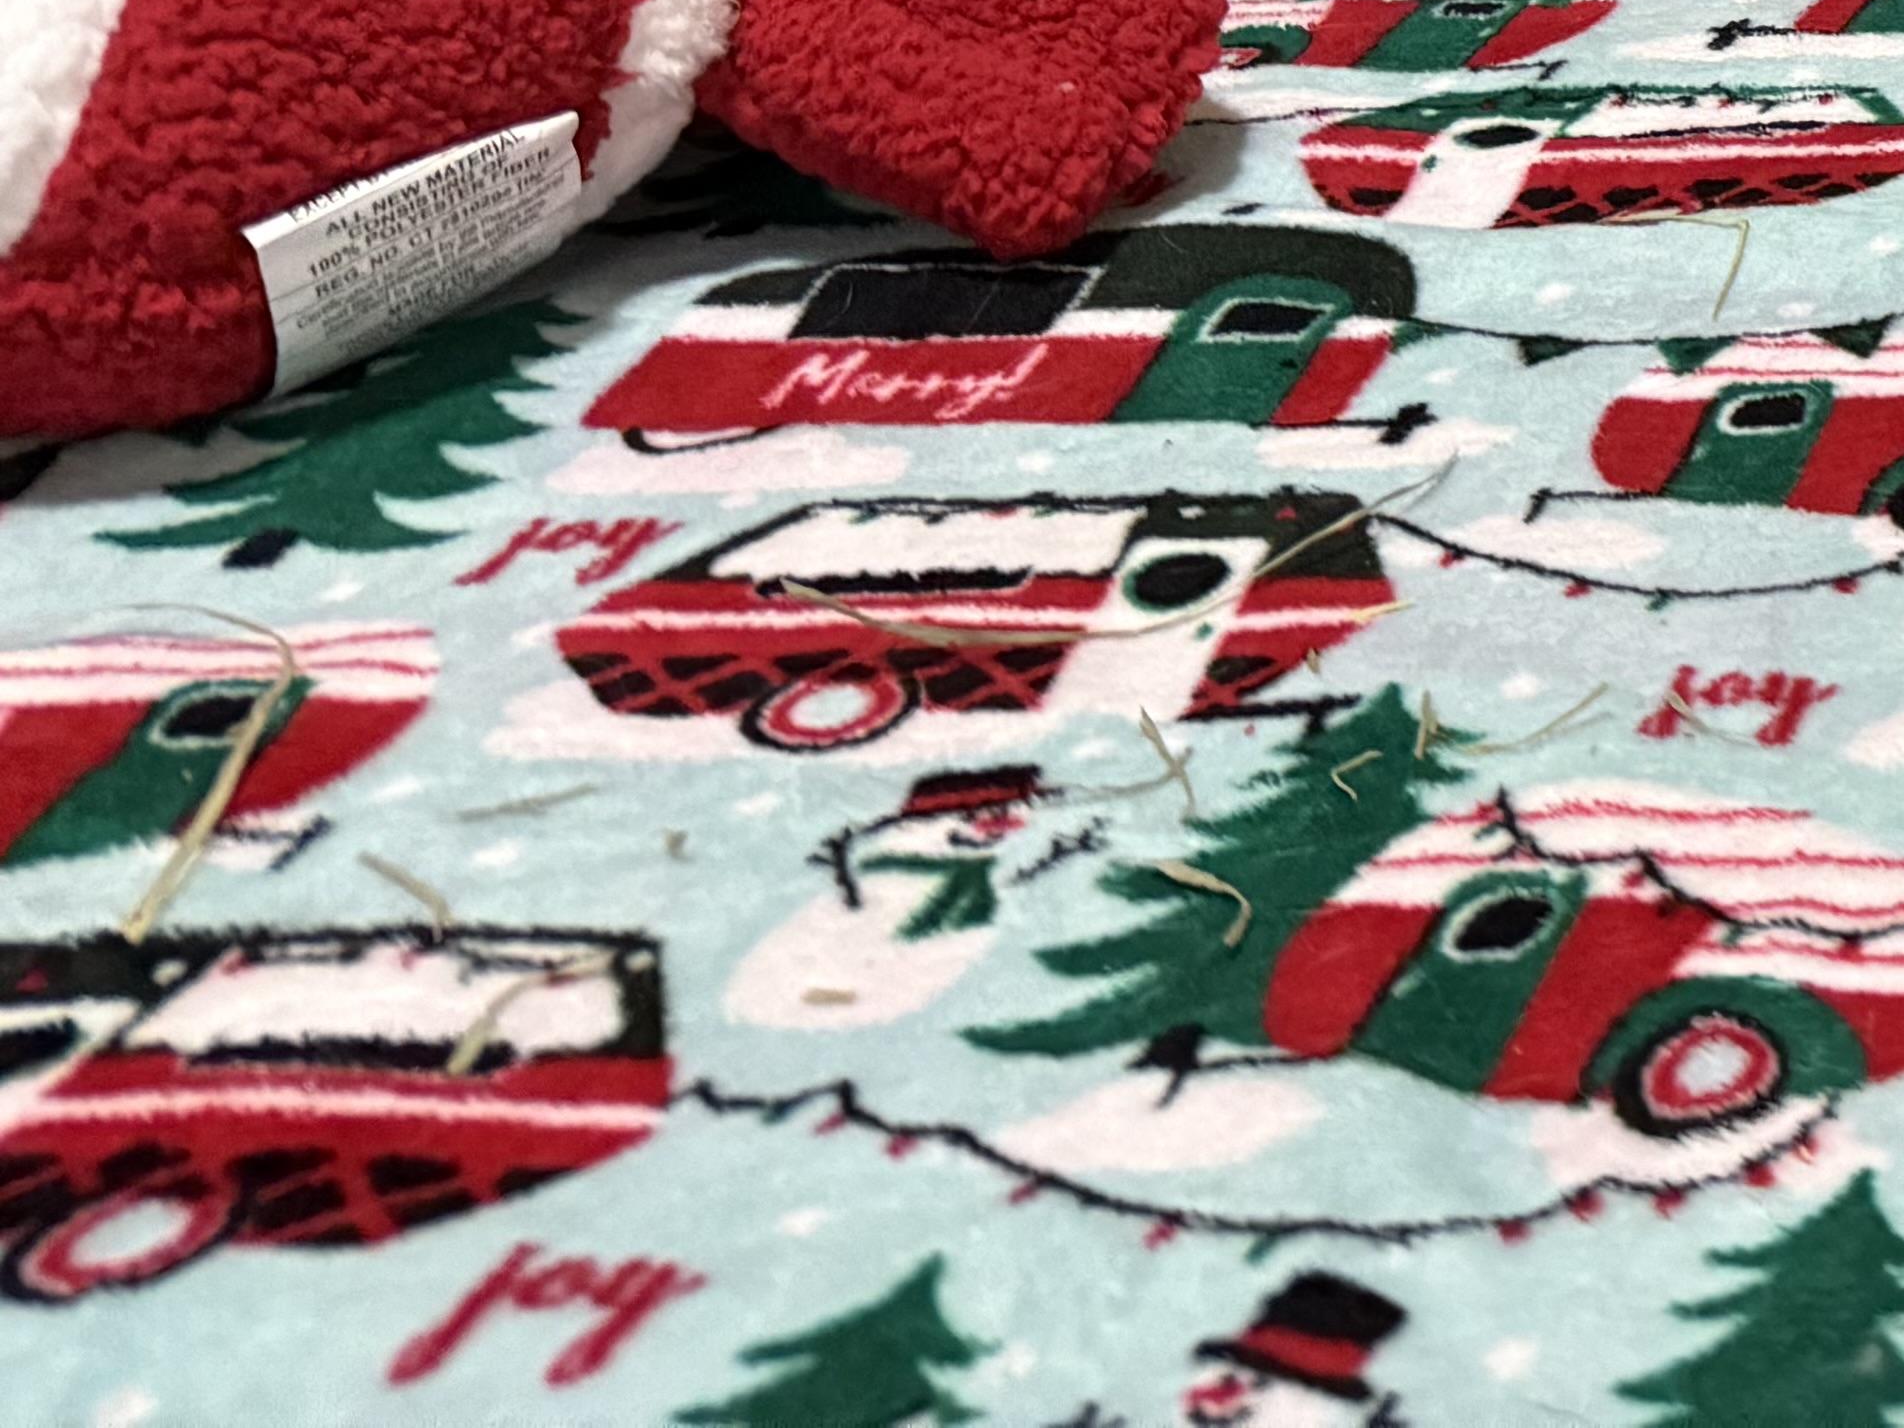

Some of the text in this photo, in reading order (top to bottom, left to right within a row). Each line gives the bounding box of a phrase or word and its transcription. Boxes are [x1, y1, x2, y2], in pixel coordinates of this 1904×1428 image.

[309, 244, 361, 278] 100%
[365, 175, 487, 248] POLYESTER
[326, 210, 361, 236] ALL
[372, 180, 421, 215] NEW
[426, 128, 526, 189] MATERIAL
[348, 170, 475, 239] CONSISTING
